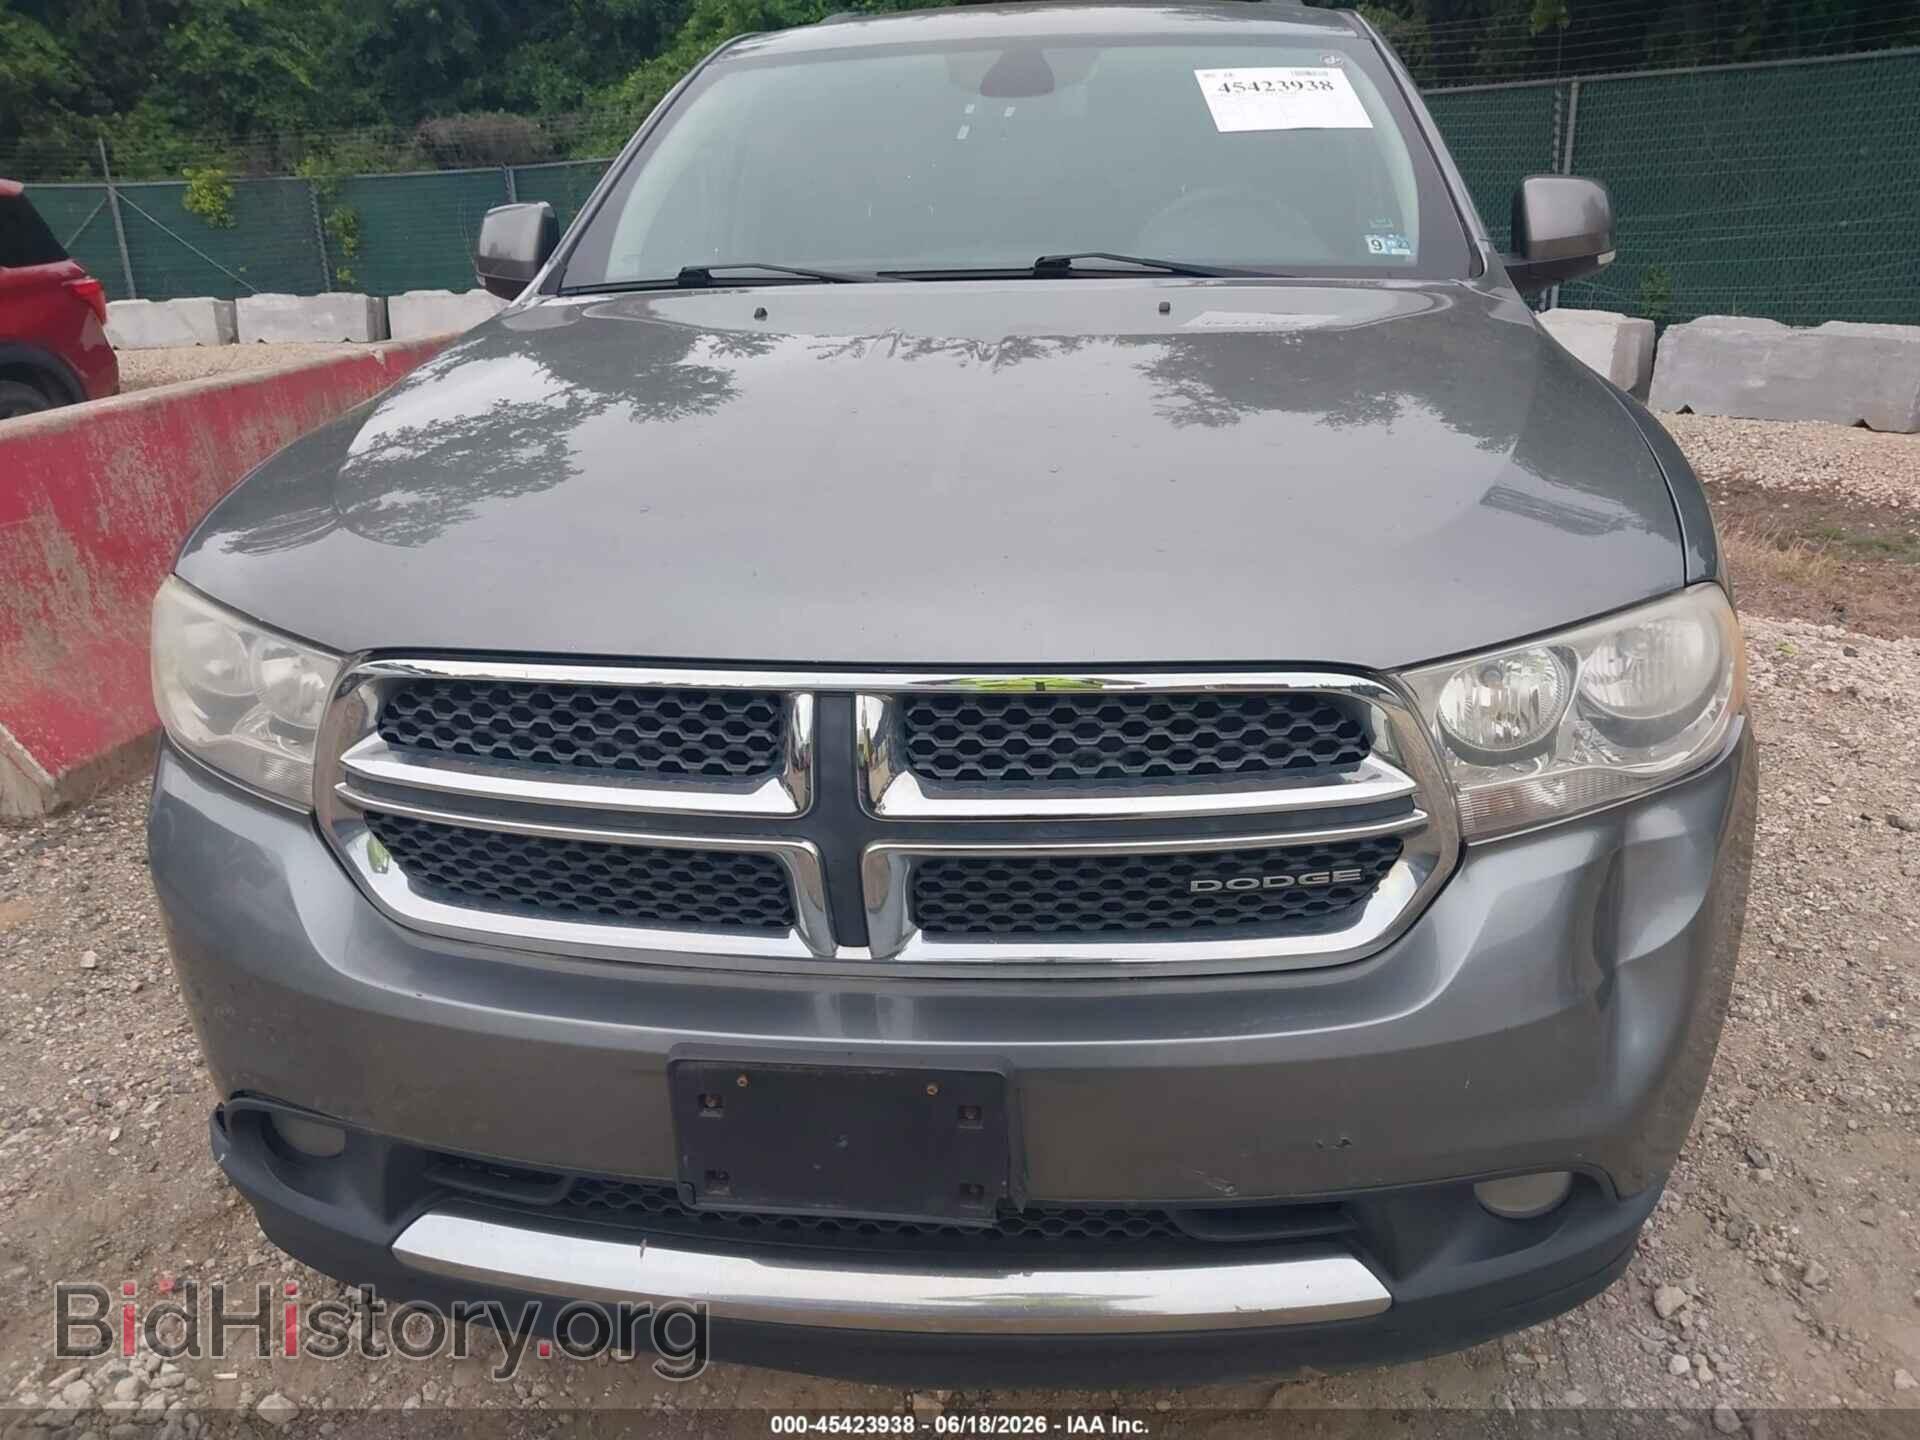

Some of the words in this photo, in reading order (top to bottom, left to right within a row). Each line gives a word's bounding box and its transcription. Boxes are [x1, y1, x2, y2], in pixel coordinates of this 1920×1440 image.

[1217, 79, 1335, 94] 45423938
[1371, 239, 1383, 251] 9
[1190, 868, 1362, 892] DODGE
